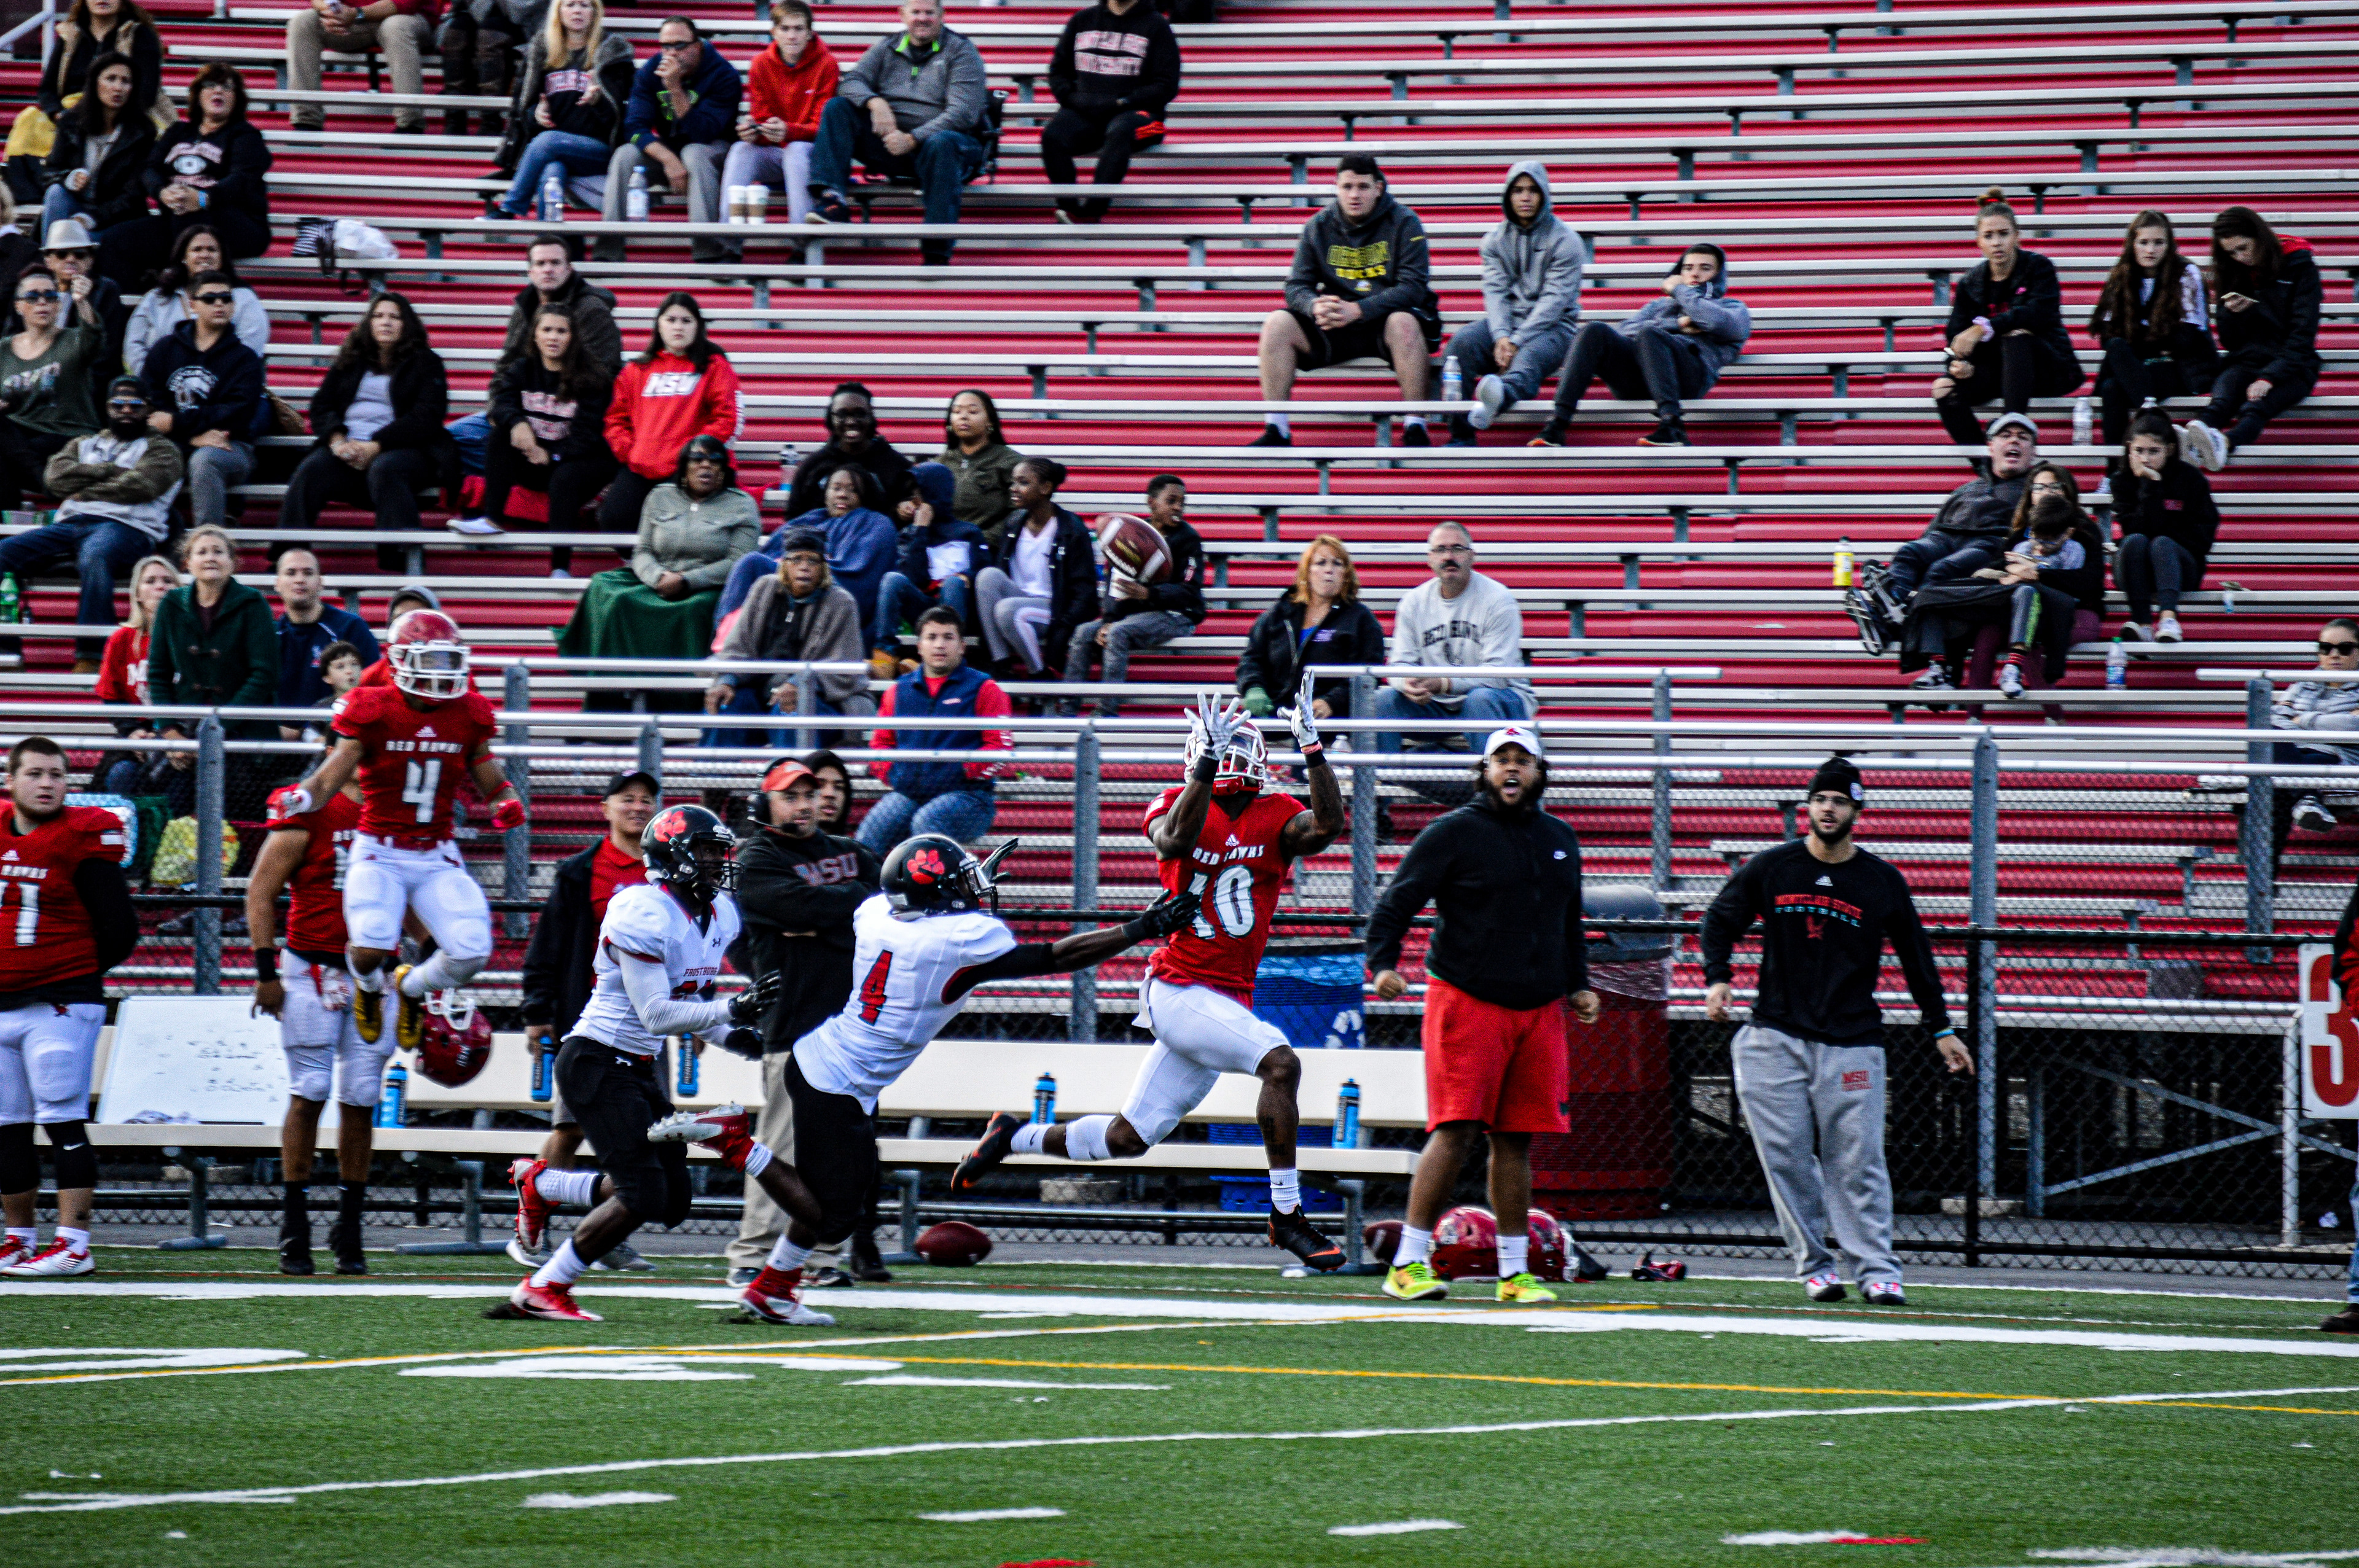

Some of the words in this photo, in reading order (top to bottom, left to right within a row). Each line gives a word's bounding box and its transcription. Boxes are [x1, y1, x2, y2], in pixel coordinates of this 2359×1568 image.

[402, 757, 442, 825] 4
[1192, 847, 1220, 865] RED
[858, 949, 893, 1027] 4
[2309, 954, 2359, 1107] 3
